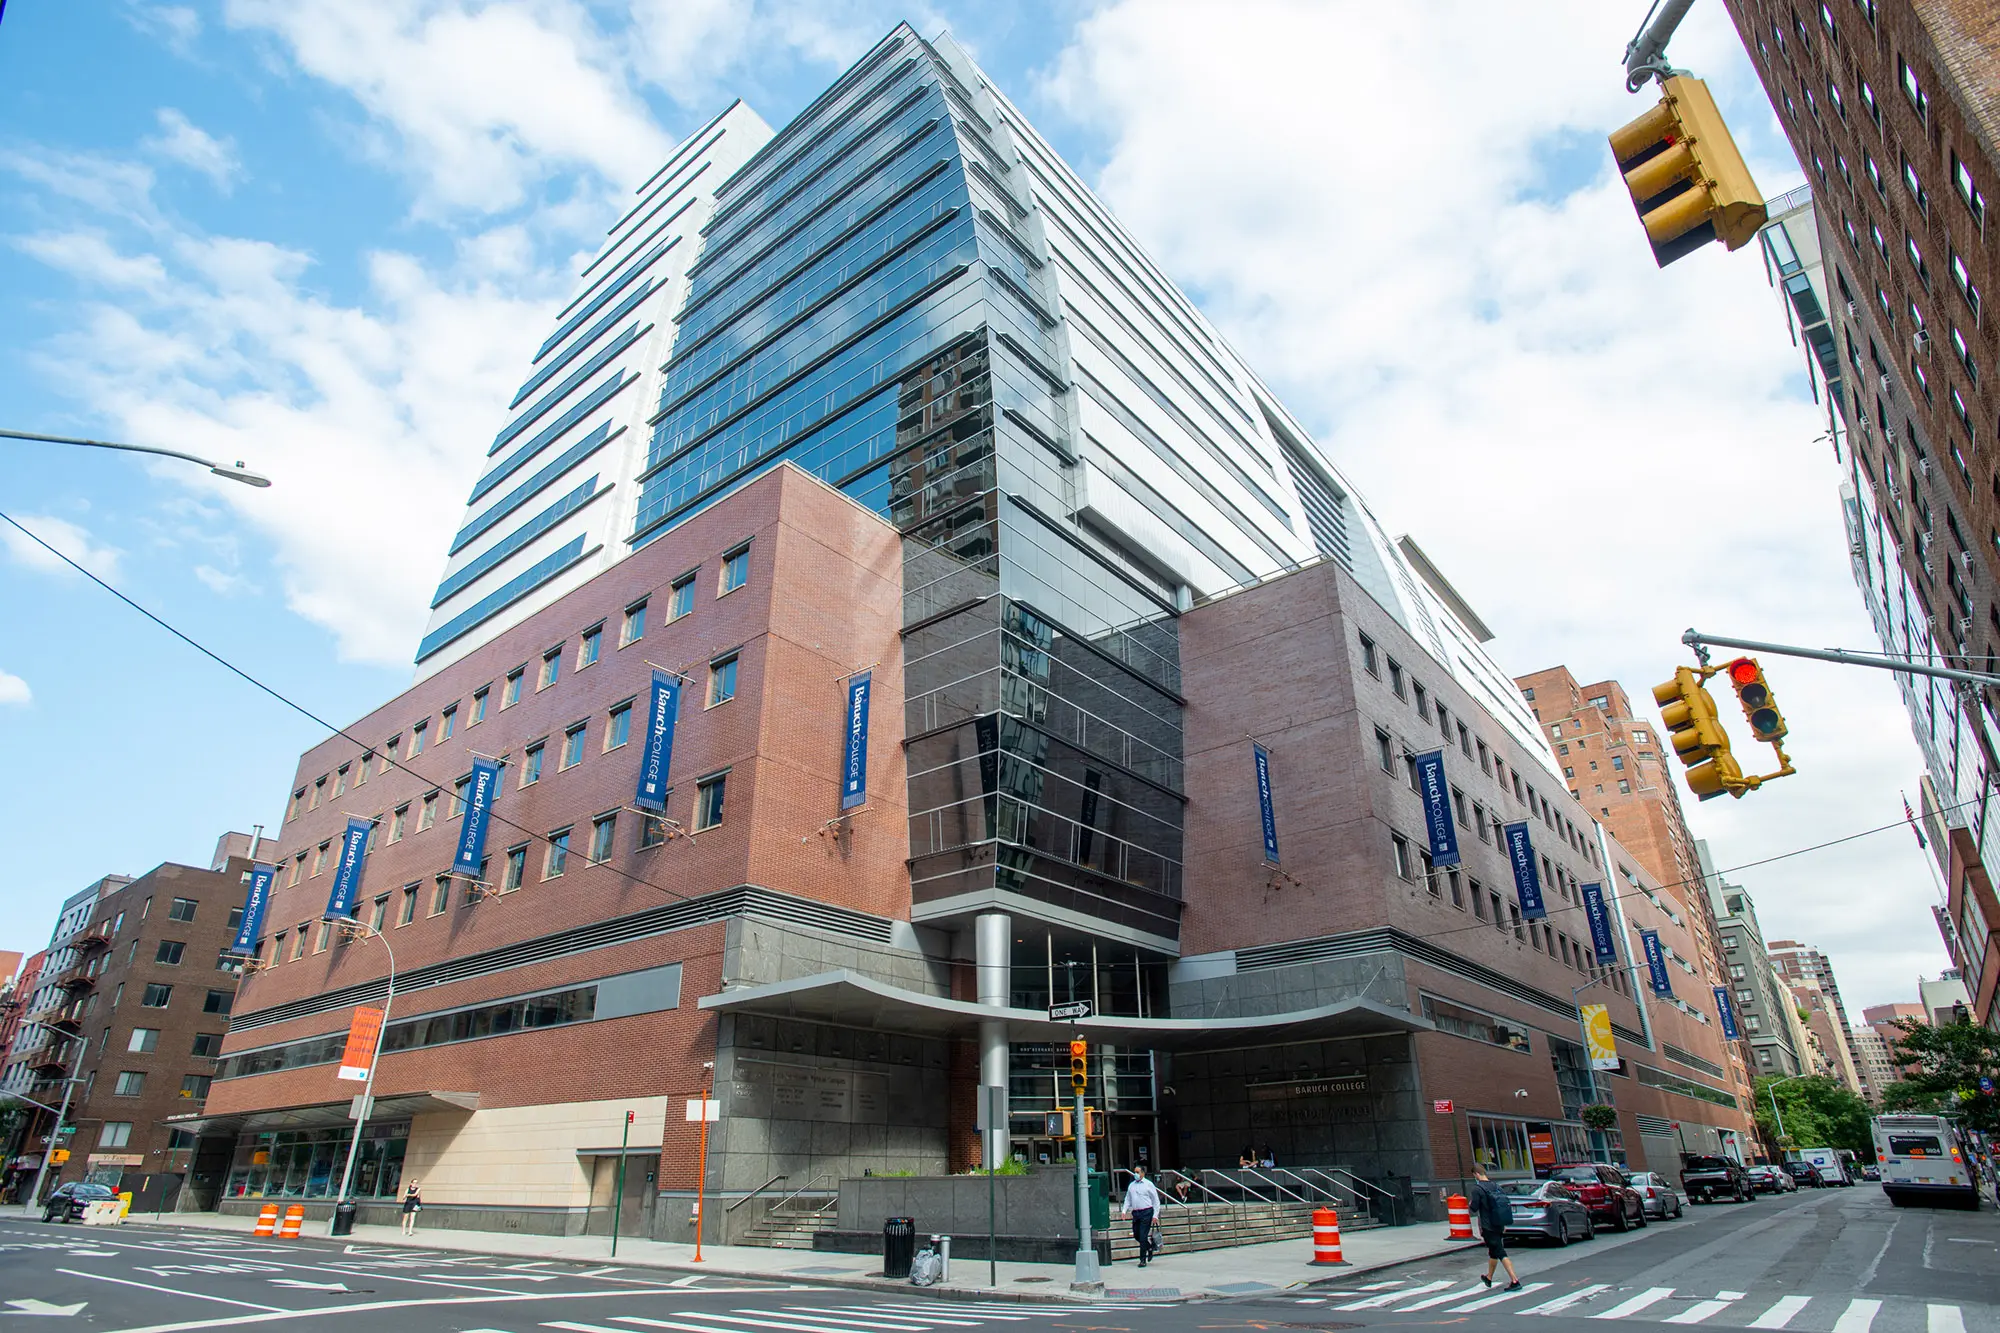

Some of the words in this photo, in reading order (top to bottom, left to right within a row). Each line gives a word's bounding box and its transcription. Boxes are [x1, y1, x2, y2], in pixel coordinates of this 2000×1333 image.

[1054, 1008, 1067, 1017] ONE
[1072, 1006, 1085, 1014] WAY
[1295, 1084, 1328, 1095] BARUCH
[1331, 1081, 1366, 1092] COLLEGE
[132, 1263, 285, 1277] ONLY
